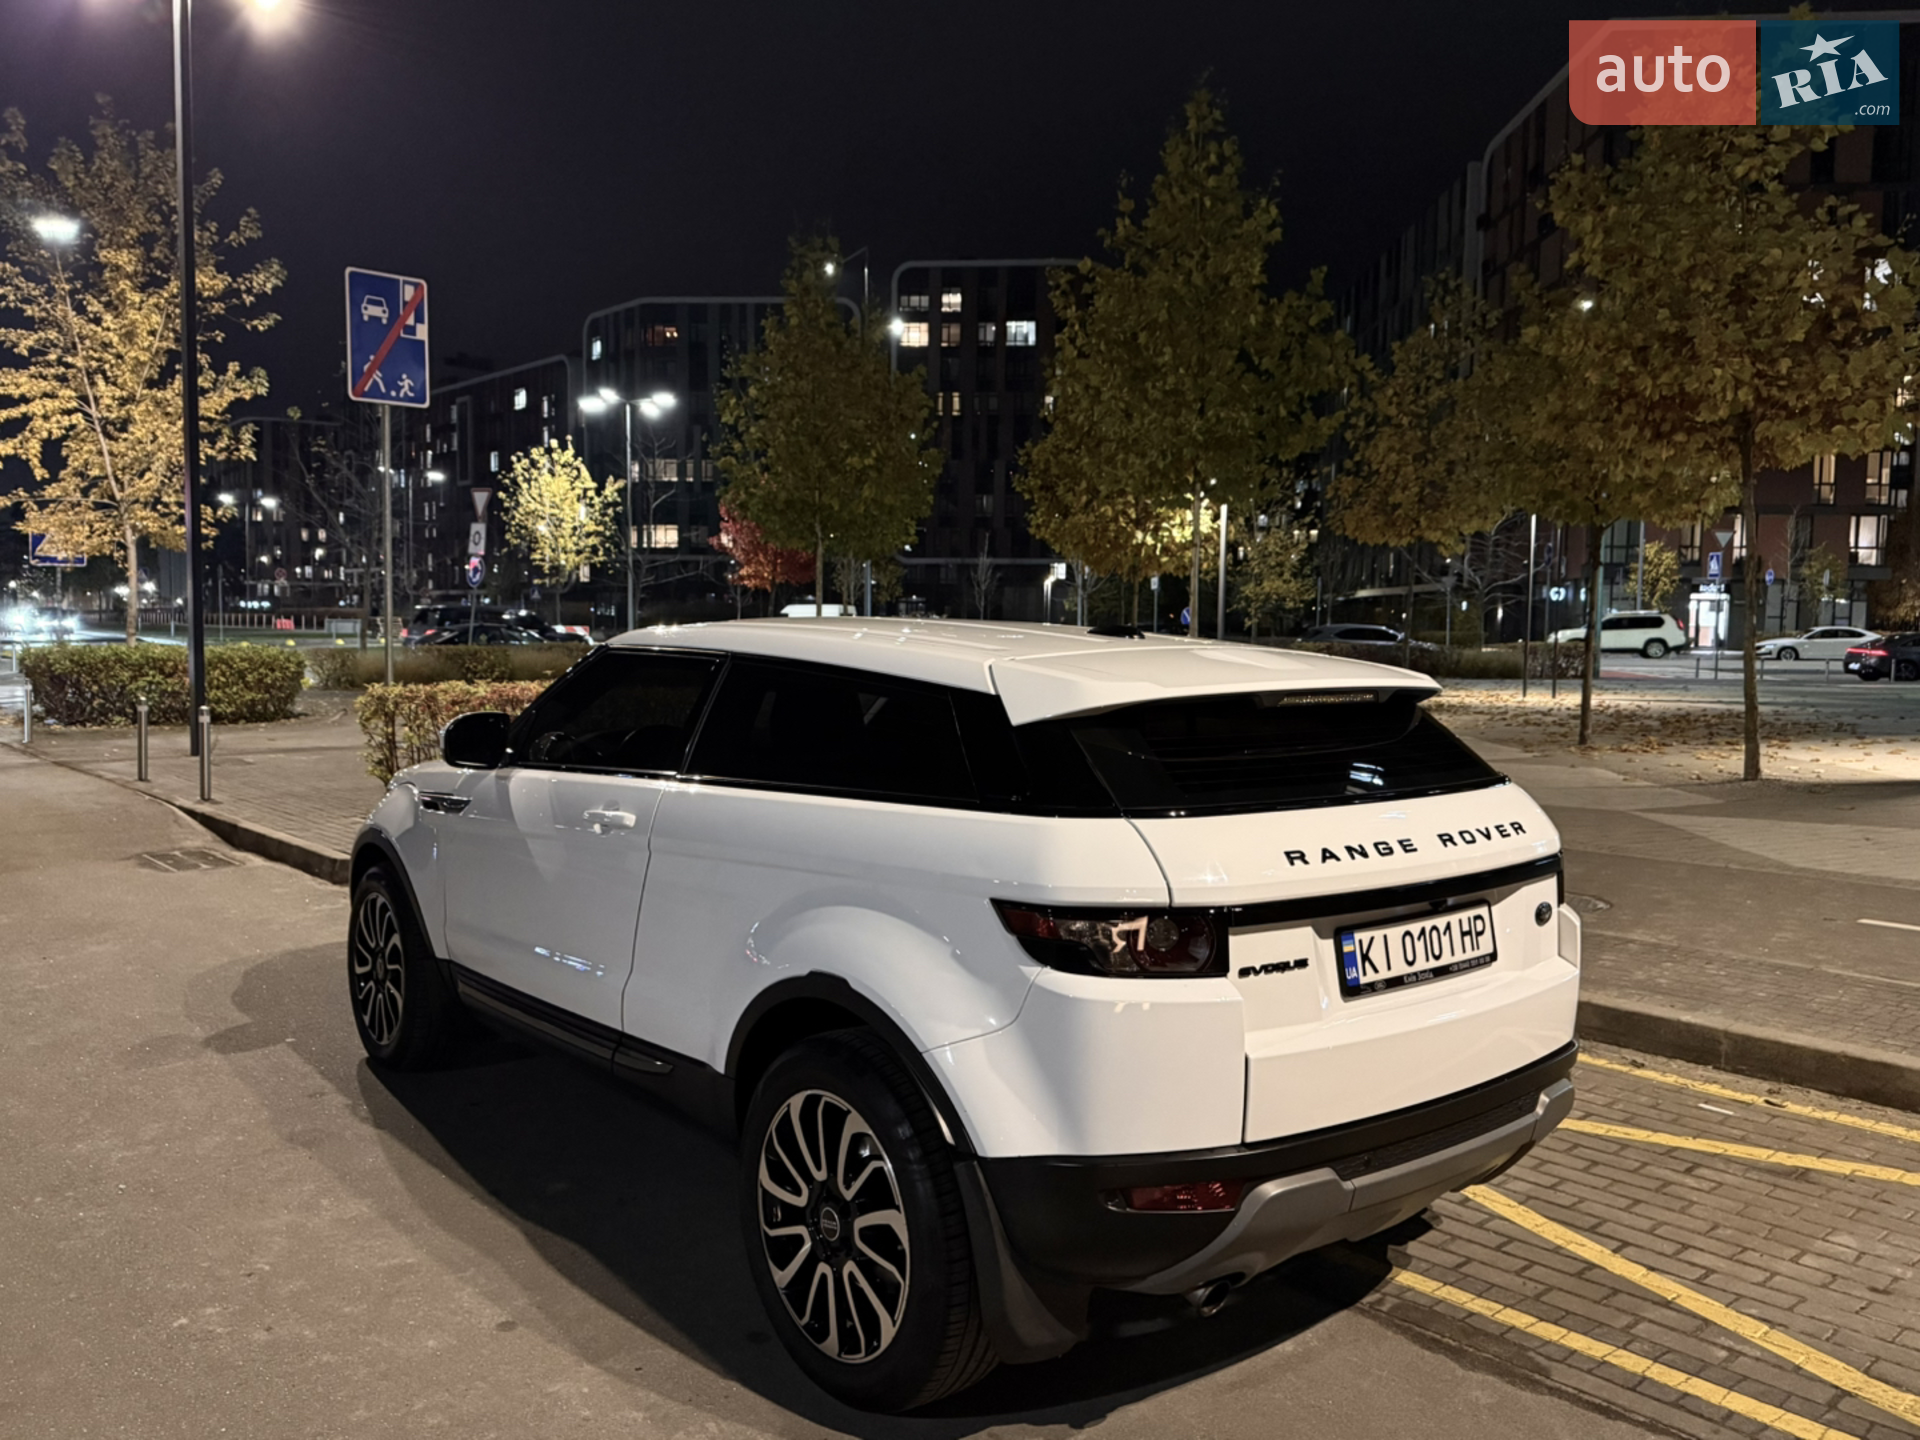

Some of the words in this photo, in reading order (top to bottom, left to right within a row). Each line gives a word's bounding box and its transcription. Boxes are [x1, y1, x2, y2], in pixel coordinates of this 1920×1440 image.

[1284, 838, 1418, 866] RANGE
[1436, 821, 1527, 848] ROVER
[1358, 933, 1391, 977] KI
[1401, 920, 1455, 967] 0101
[1458, 914, 1486, 954] HP
[1345, 966, 1358, 980] UA
